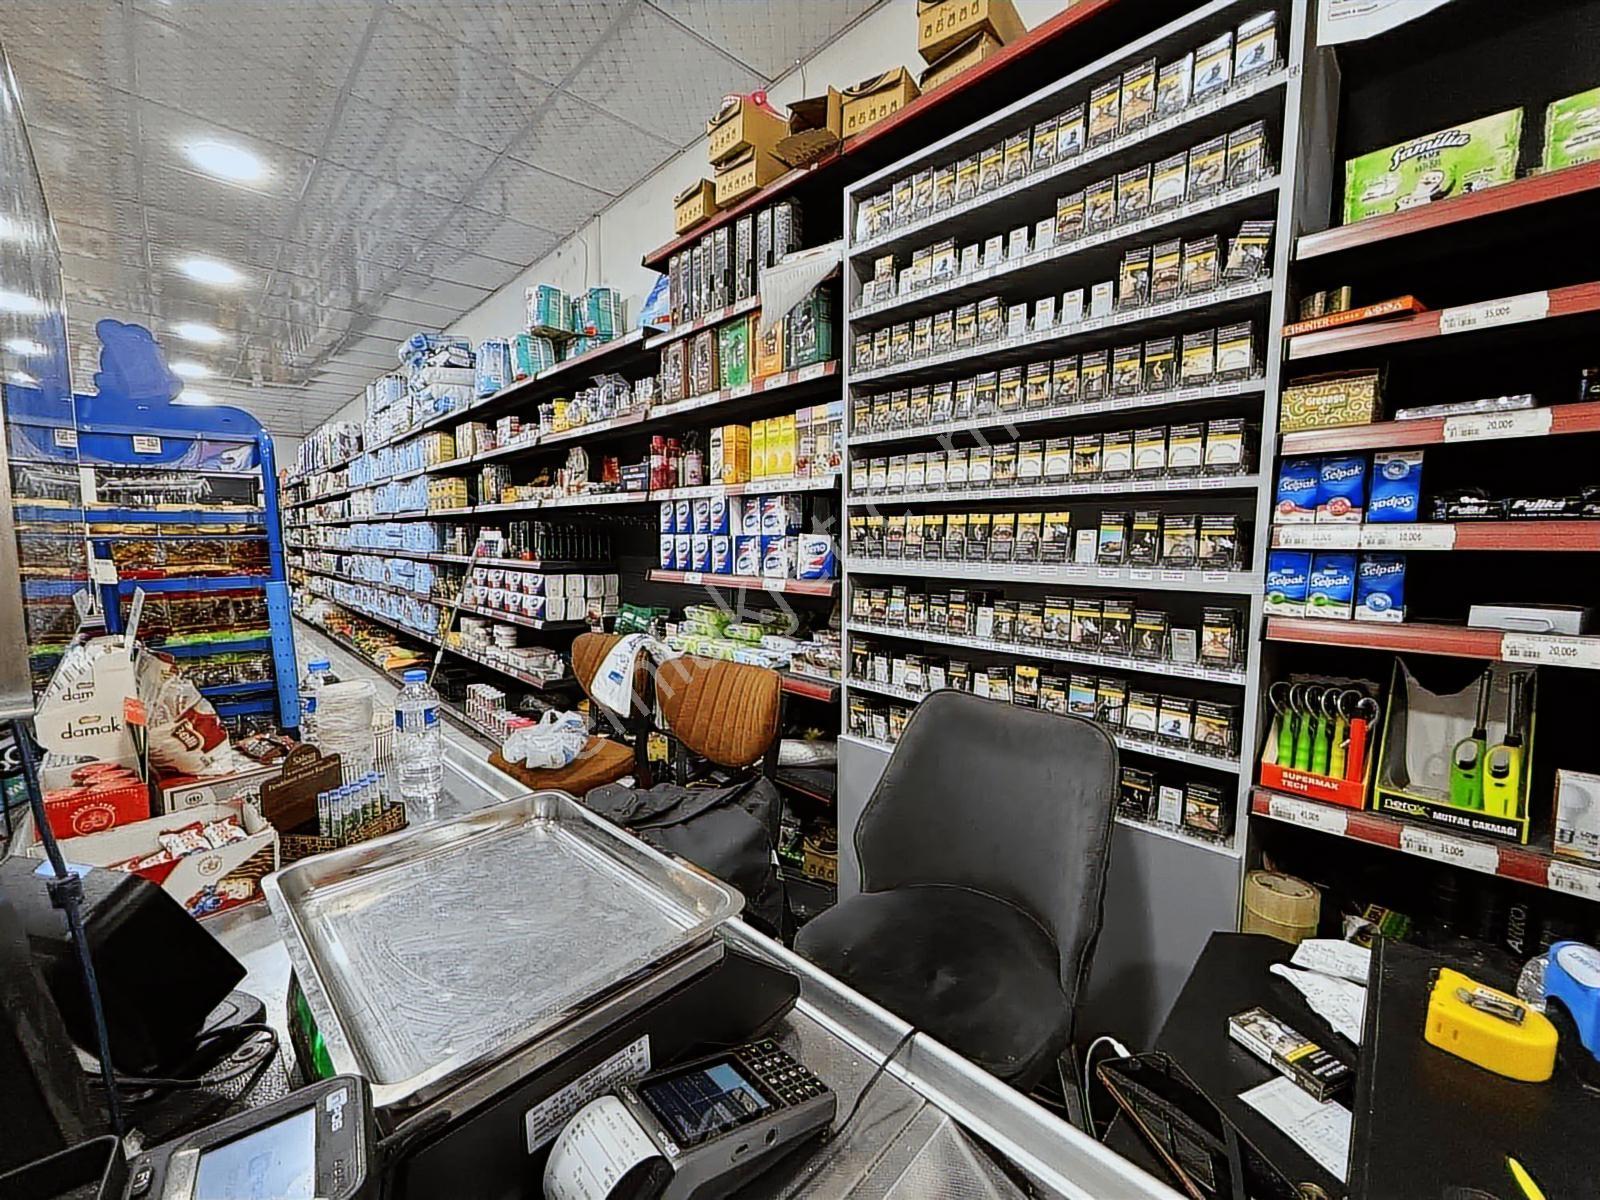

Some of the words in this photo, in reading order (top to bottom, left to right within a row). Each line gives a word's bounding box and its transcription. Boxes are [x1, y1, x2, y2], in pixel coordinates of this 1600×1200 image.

[1323, 464, 1363, 481] Selpak
[1281, 478, 1318, 492] Selpak
[1371, 495, 1414, 512] Selpak
[1361, 562, 1404, 577] Selpak
[1269, 574, 1306, 587] Selpak
[1311, 574, 1350, 588] Selpak
[62, 687, 94, 701] dam
[61, 716, 121, 739] damak
[1281, 779, 1308, 791] TECH
[1282, 771, 1339, 791] SUPERMAX
[1432, 811, 1470, 828] MUTFAK
